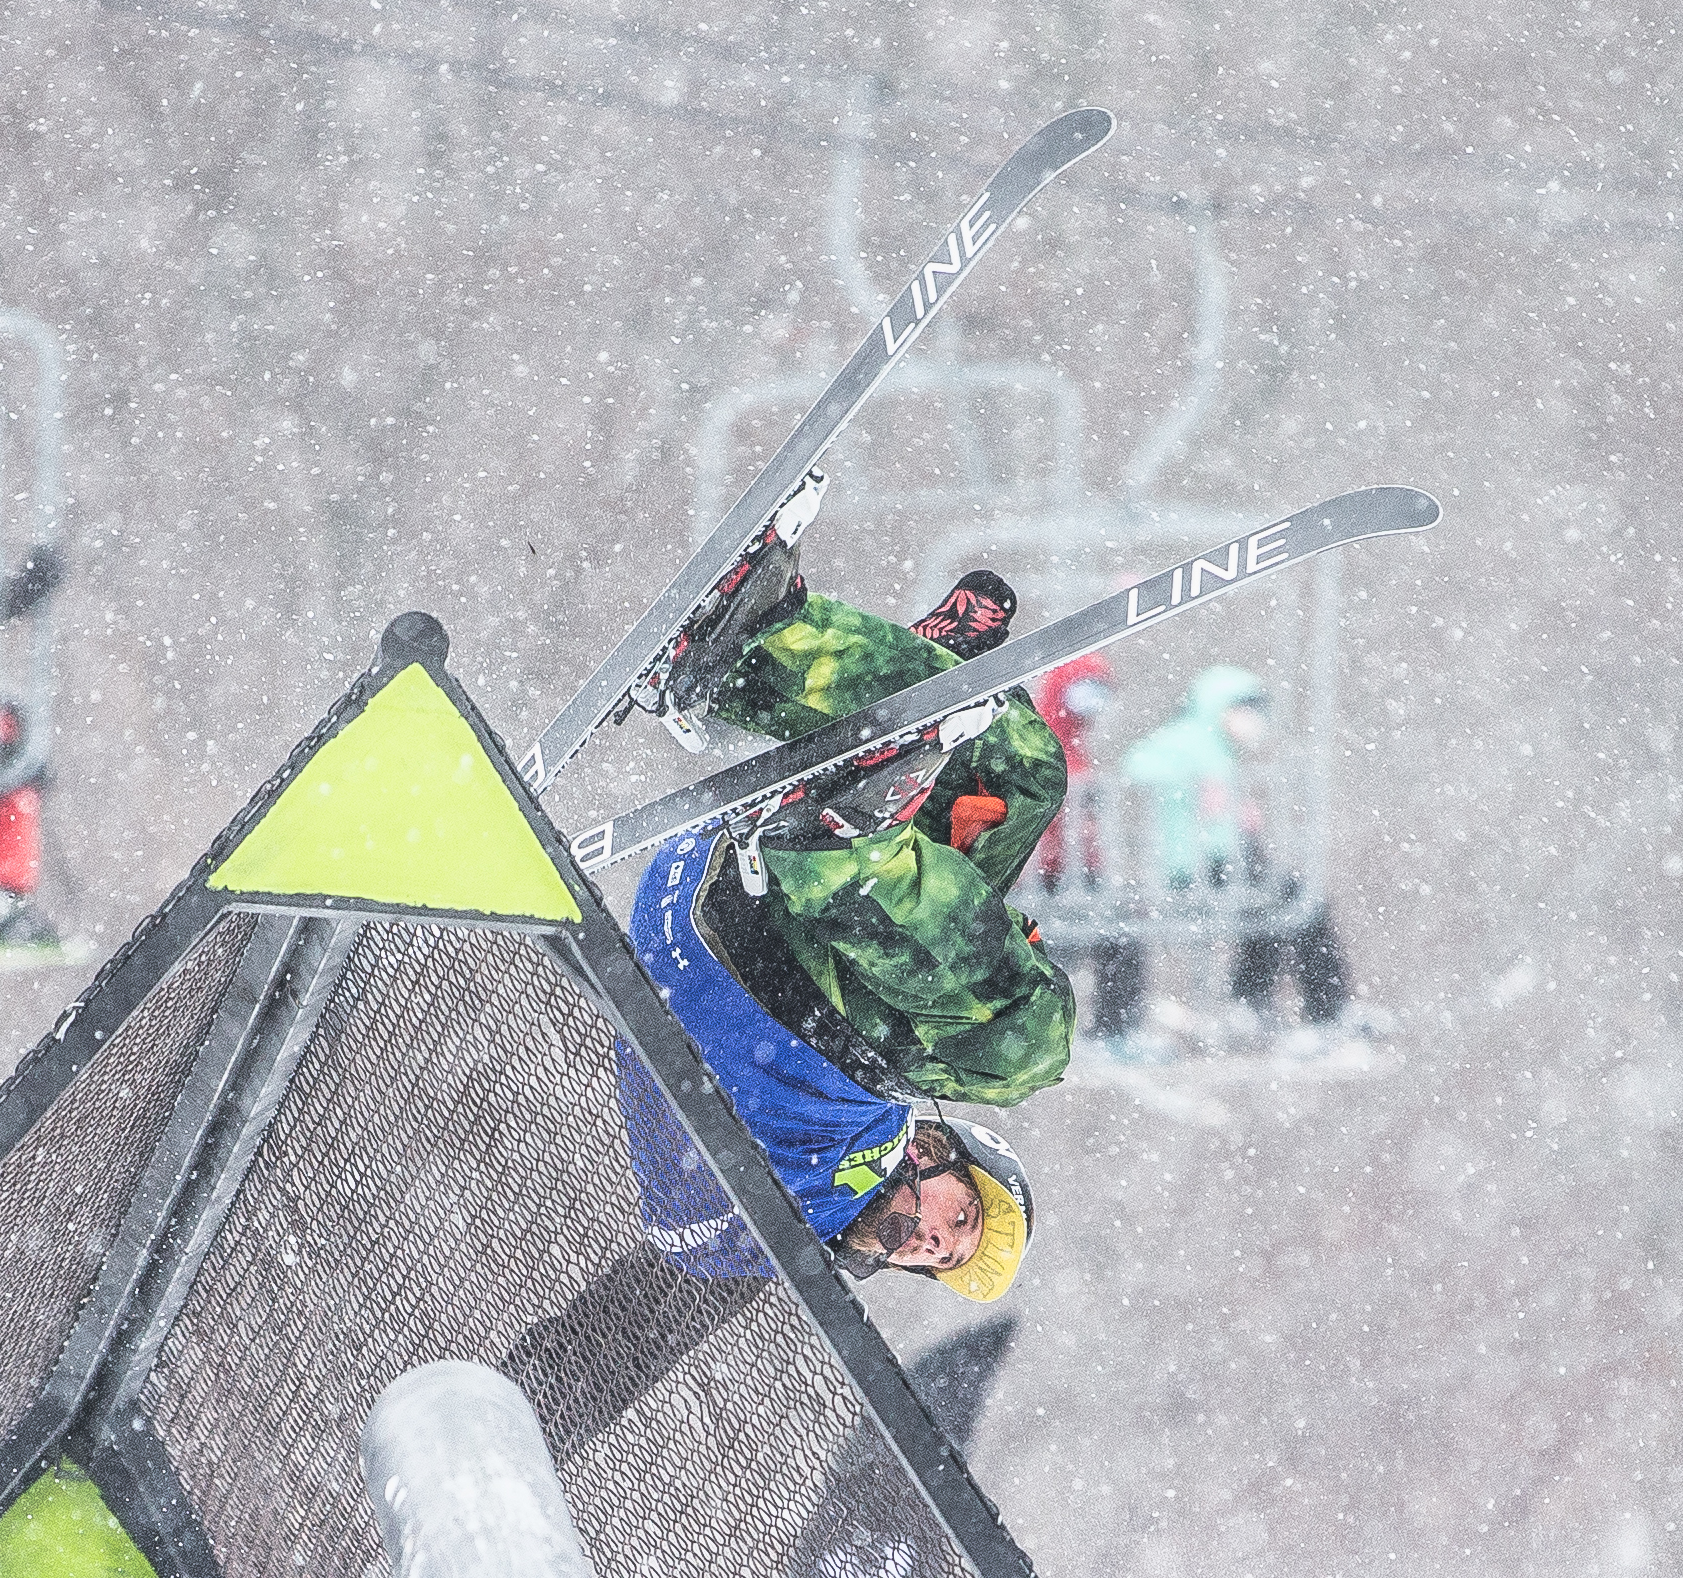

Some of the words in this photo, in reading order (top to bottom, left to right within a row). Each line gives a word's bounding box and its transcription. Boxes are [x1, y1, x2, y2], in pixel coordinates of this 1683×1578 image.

[881, 191, 997, 356] LINE
[1126, 521, 1292, 626] LINE
[1007, 1174, 1028, 1222] VERM
